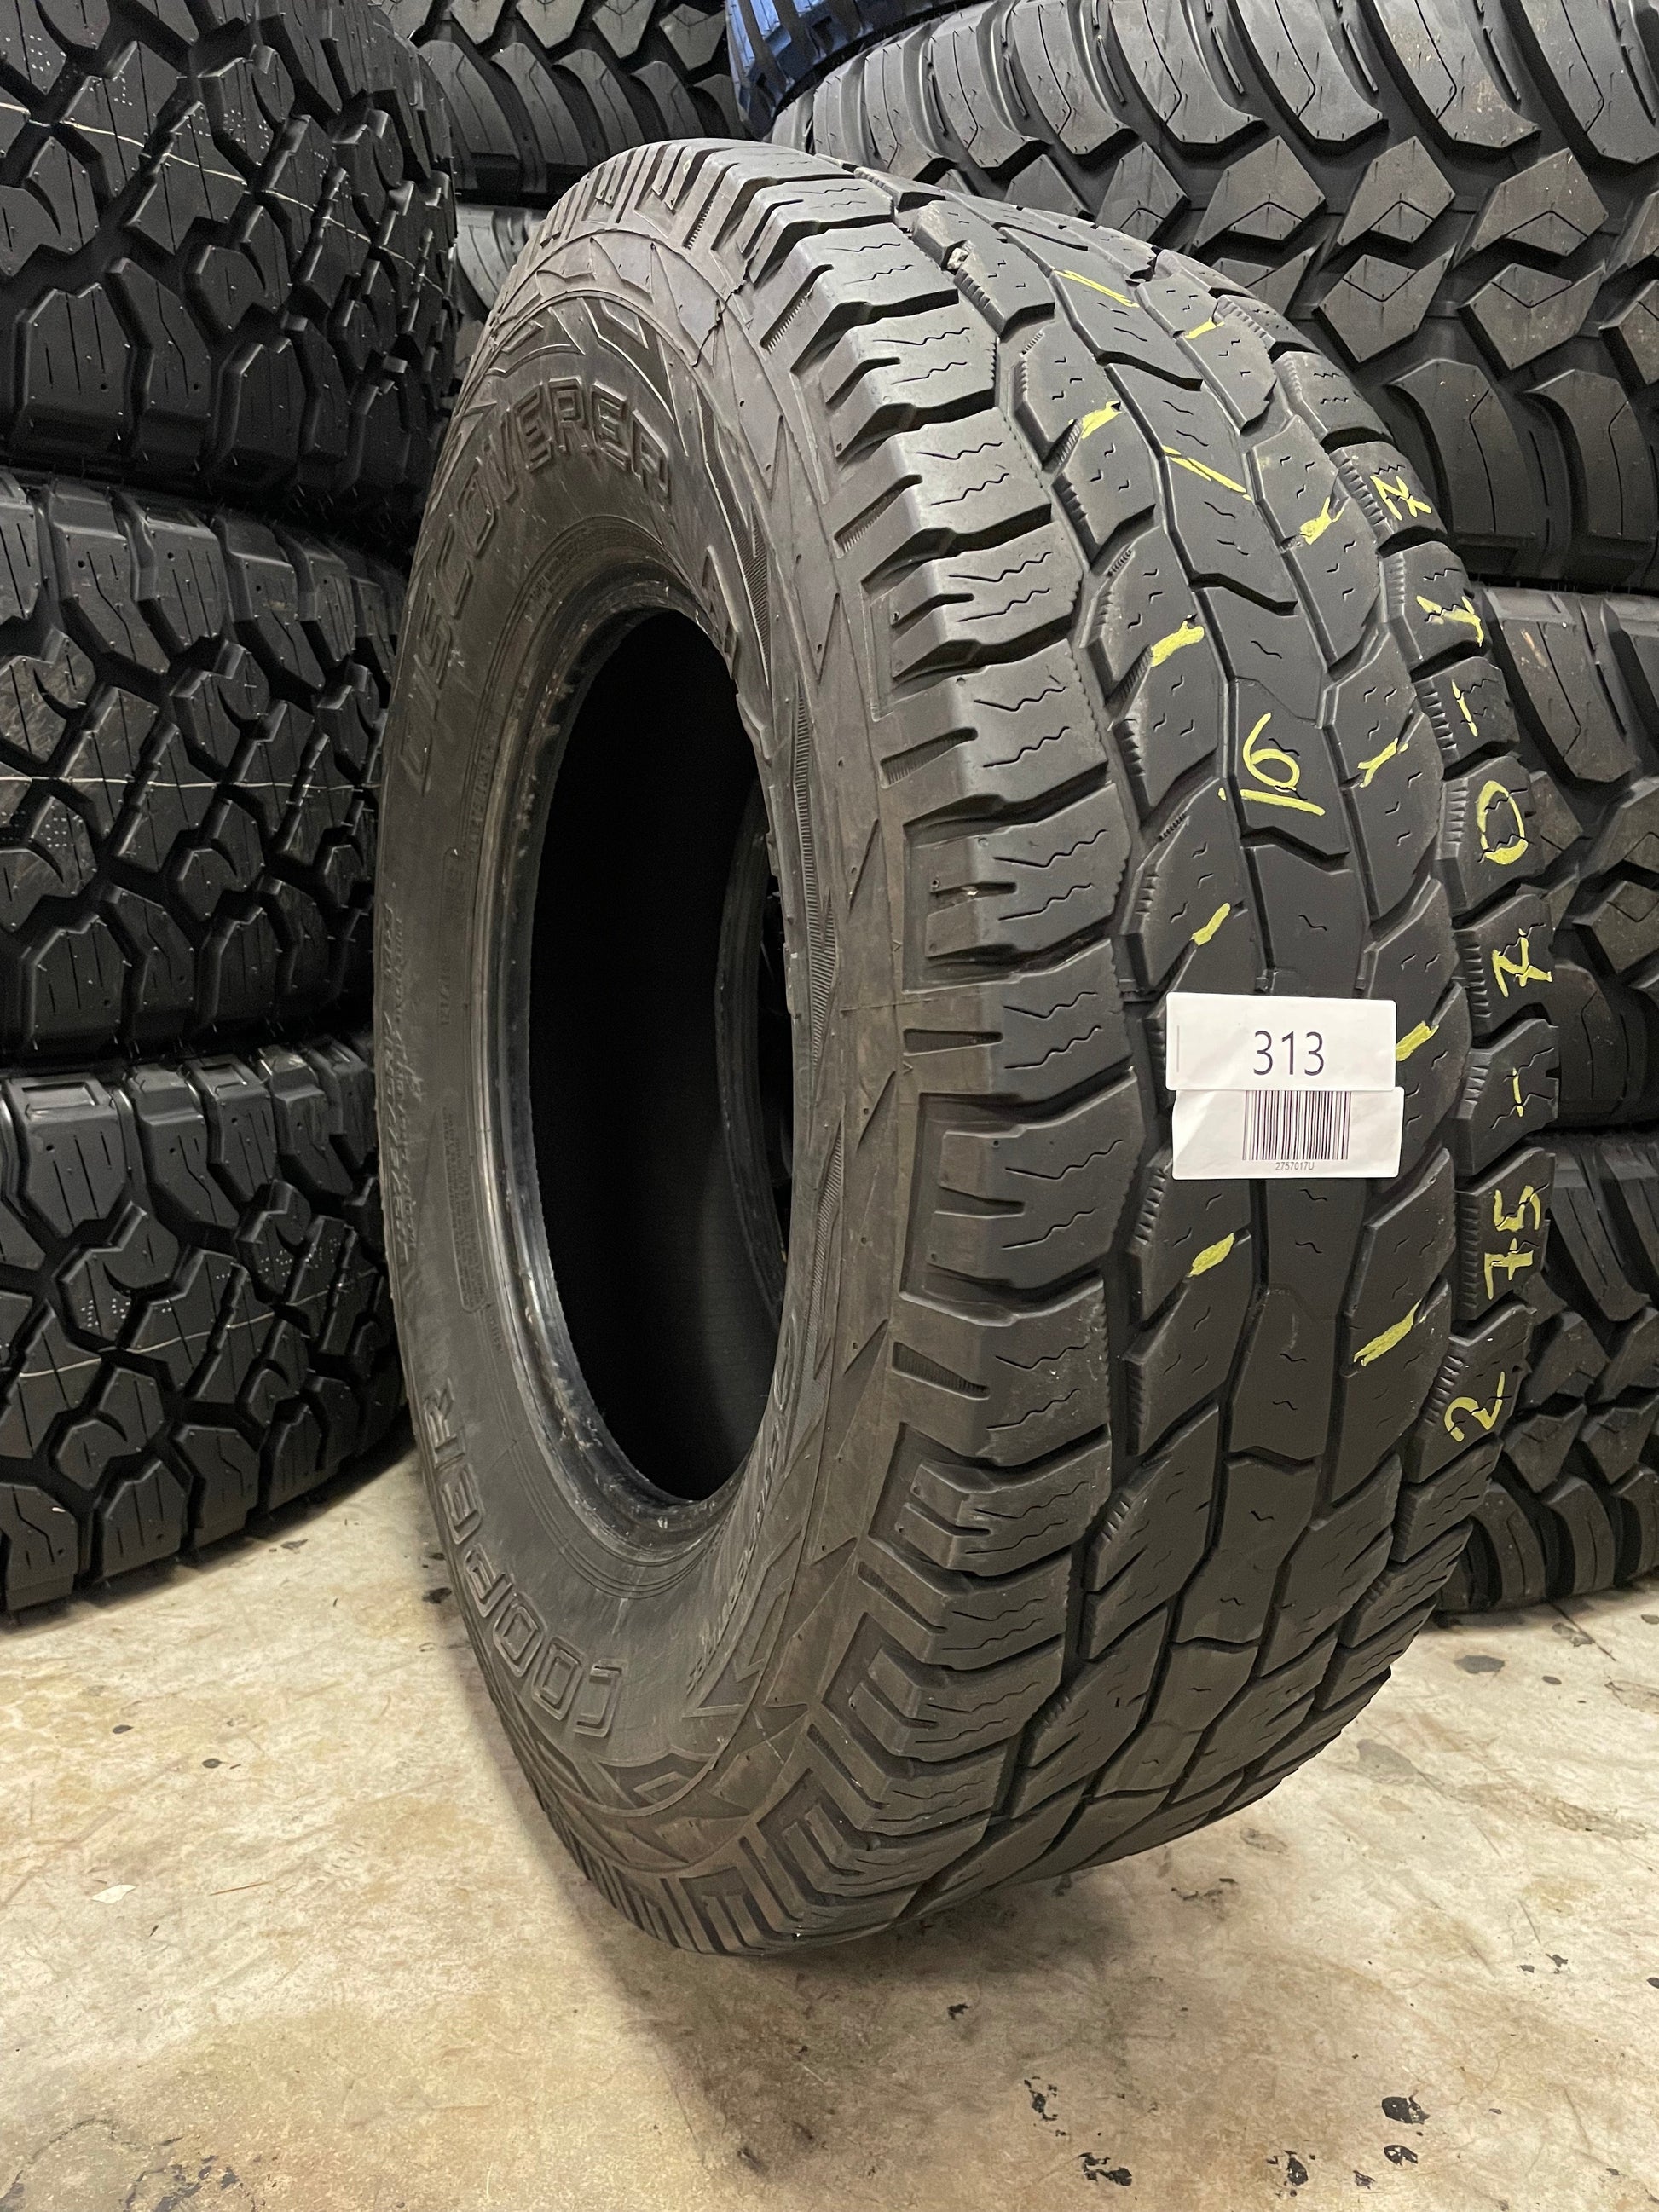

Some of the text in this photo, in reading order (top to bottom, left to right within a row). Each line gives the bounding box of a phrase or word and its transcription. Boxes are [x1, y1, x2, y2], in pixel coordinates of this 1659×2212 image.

[1252, 1030, 1325, 1077] 313
[1275, 1161, 1315, 1171] 2757017U
[425, 1377, 629, 1739] COOPER
